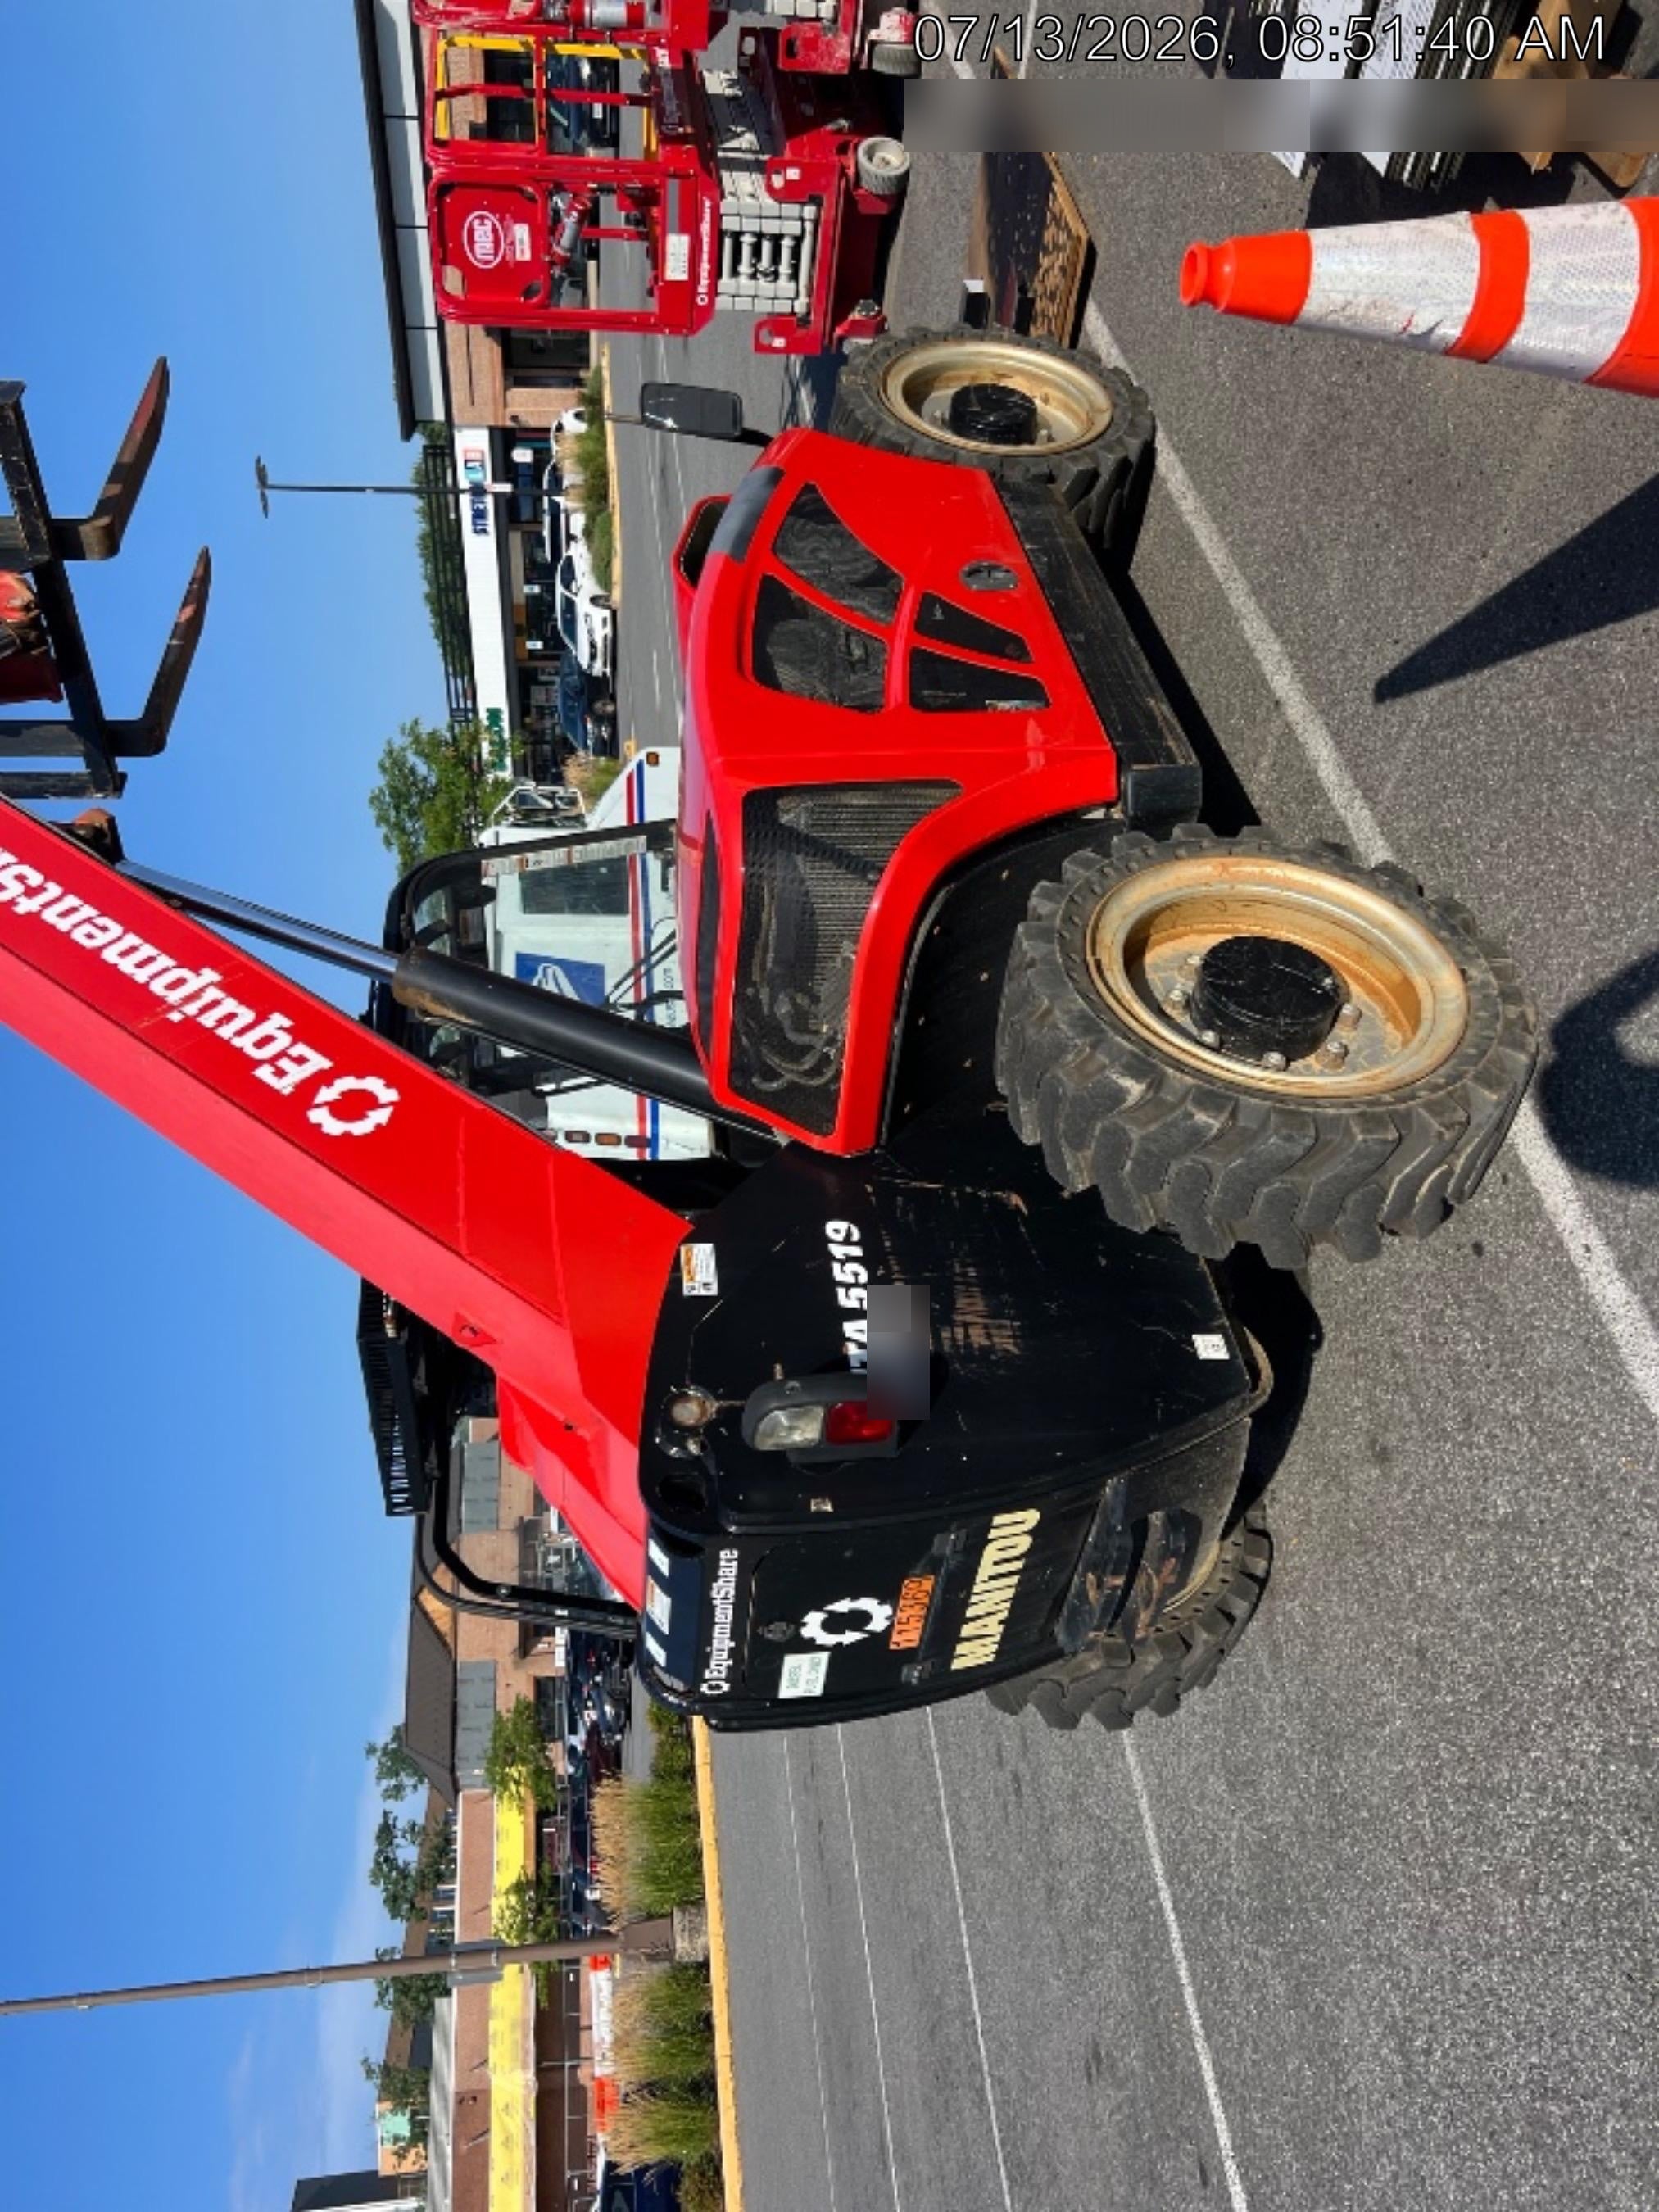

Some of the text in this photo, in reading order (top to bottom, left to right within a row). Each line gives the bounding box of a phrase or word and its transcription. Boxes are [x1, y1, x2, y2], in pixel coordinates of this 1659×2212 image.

[824, 1220, 868, 1310] 5519
[705, 1548, 738, 1679] EquipmentShare
[950, 1507, 1040, 1670] MANITOU
